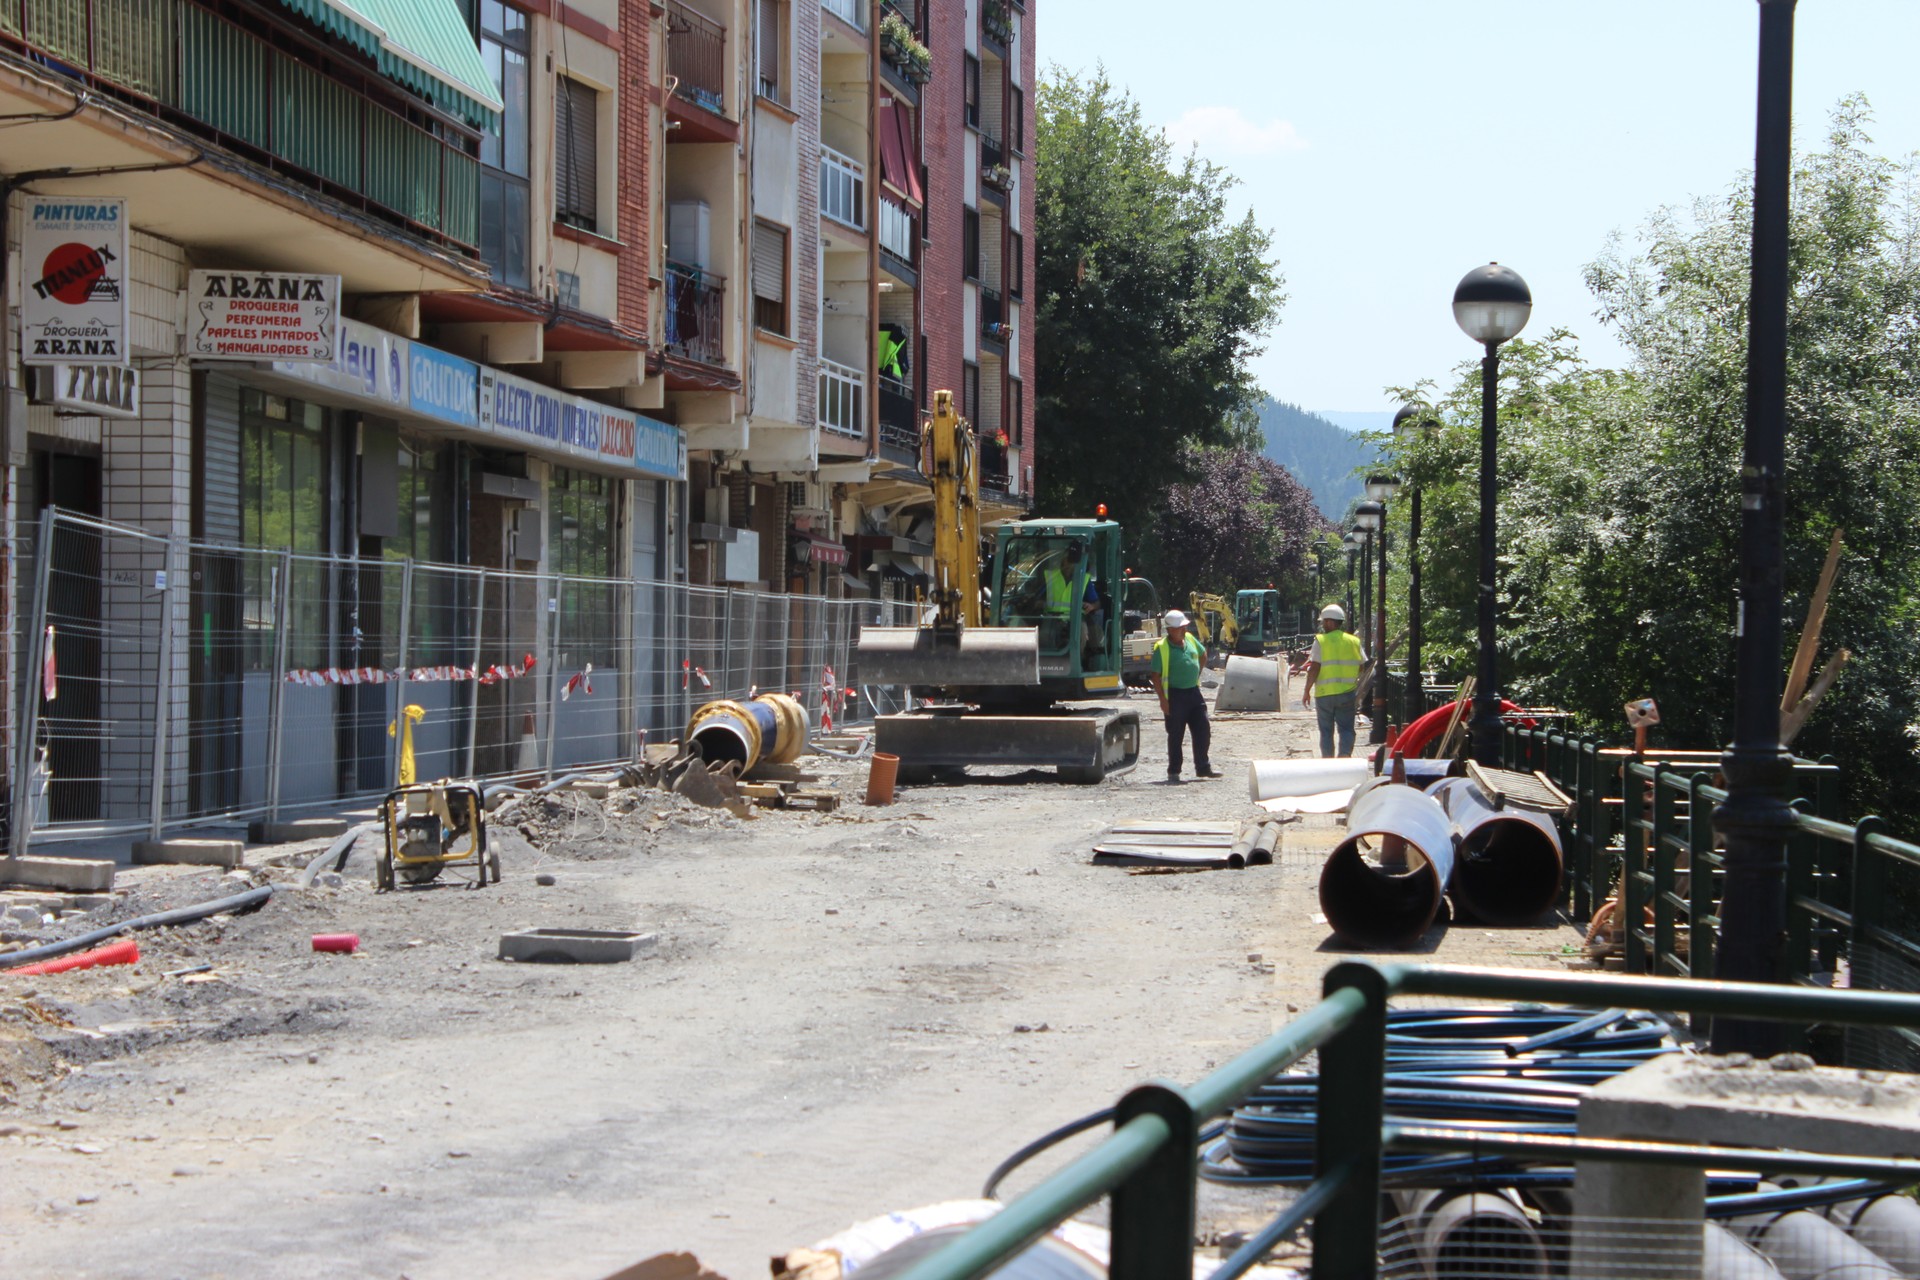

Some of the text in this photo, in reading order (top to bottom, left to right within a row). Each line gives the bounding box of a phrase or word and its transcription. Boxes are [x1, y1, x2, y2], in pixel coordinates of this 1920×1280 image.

[33, 204, 118, 220] PINTURAS
[35, 222, 118, 231] ESMALTE SINTETICO
[32, 243, 117, 300] TITANLUX
[204, 275, 325, 301] ARANA
[229, 300, 299, 313] DROGUERIA
[226, 314, 302, 327] PERFUMERIA
[43, 326, 109, 337] DROGUERIA
[207, 327, 320, 342] PAPELES PINTADOS
[33, 339, 117, 355] ARANA
[216, 342, 309, 356] MANUALIDADES
